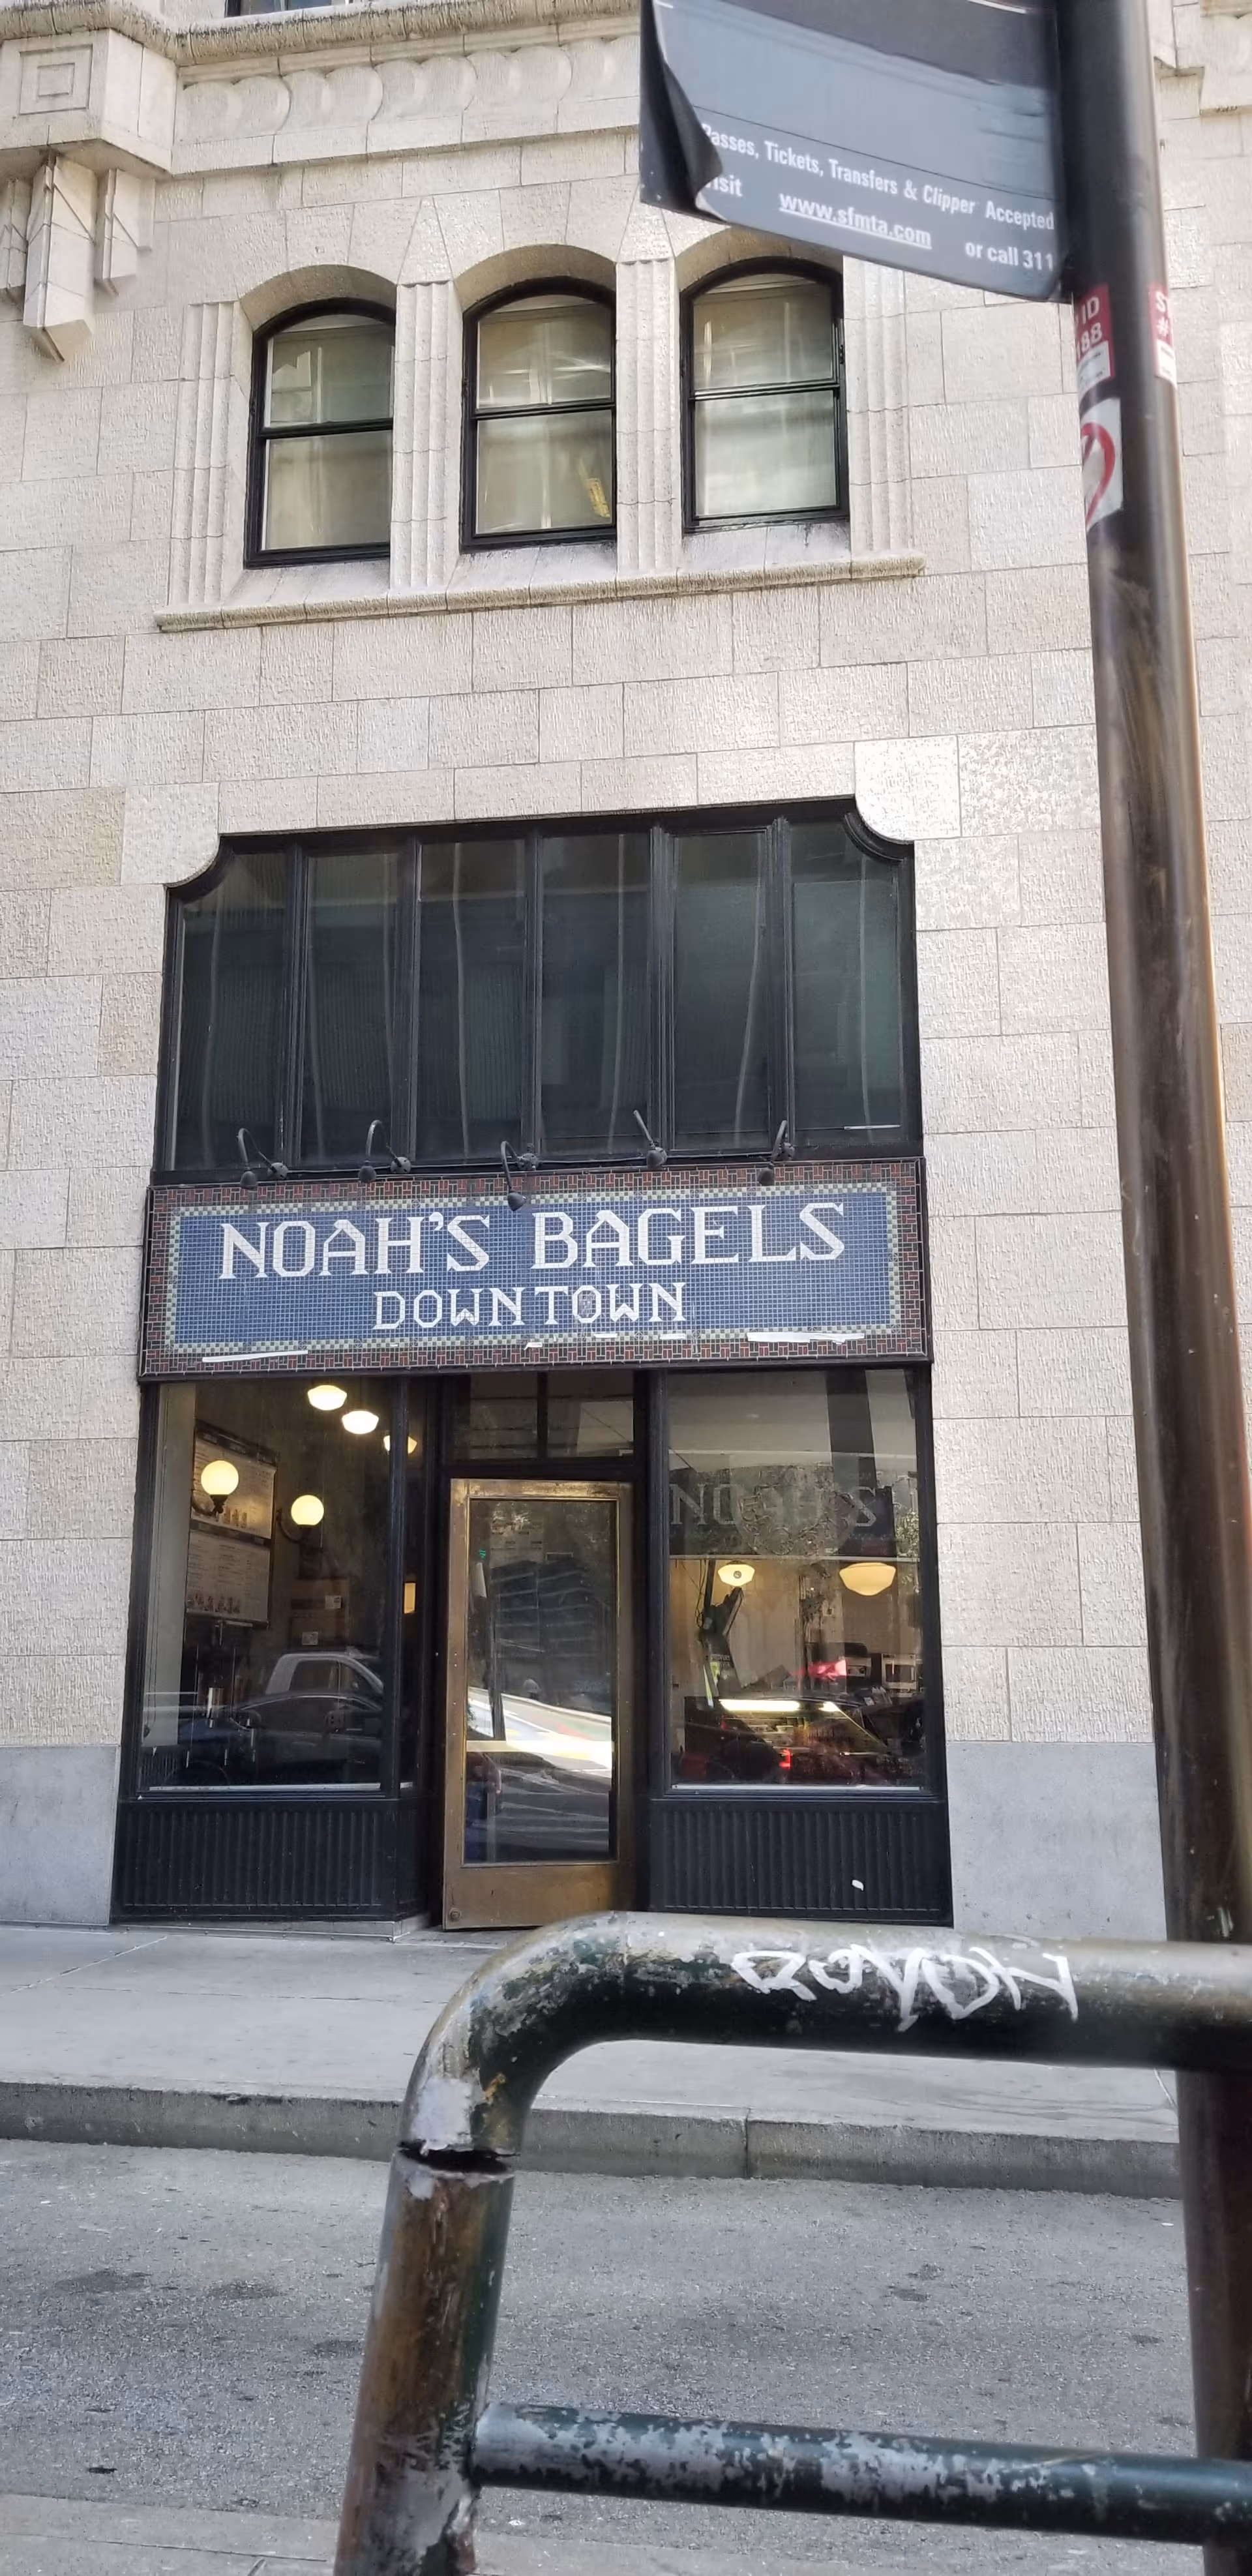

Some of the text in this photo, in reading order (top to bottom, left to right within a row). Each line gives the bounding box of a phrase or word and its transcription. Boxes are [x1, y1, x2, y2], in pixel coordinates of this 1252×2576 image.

[764, 140, 824, 177] Tickets,
[828, 158, 898, 194] Transfers
[903, 179, 917, 200] &
[923, 185, 976, 215] Clipper
[985, 200, 1054, 230] Accepted
[706, 174, 1053, 271] isit www.sfmta.com or call 311
[1081, 297, 1100, 324] ID
[218, 1202, 845, 1279] NOAH'S BAGELS
[372, 1281, 687, 1330] DOWNTOWN
[669, 1482, 877, 1528] NOAHS
